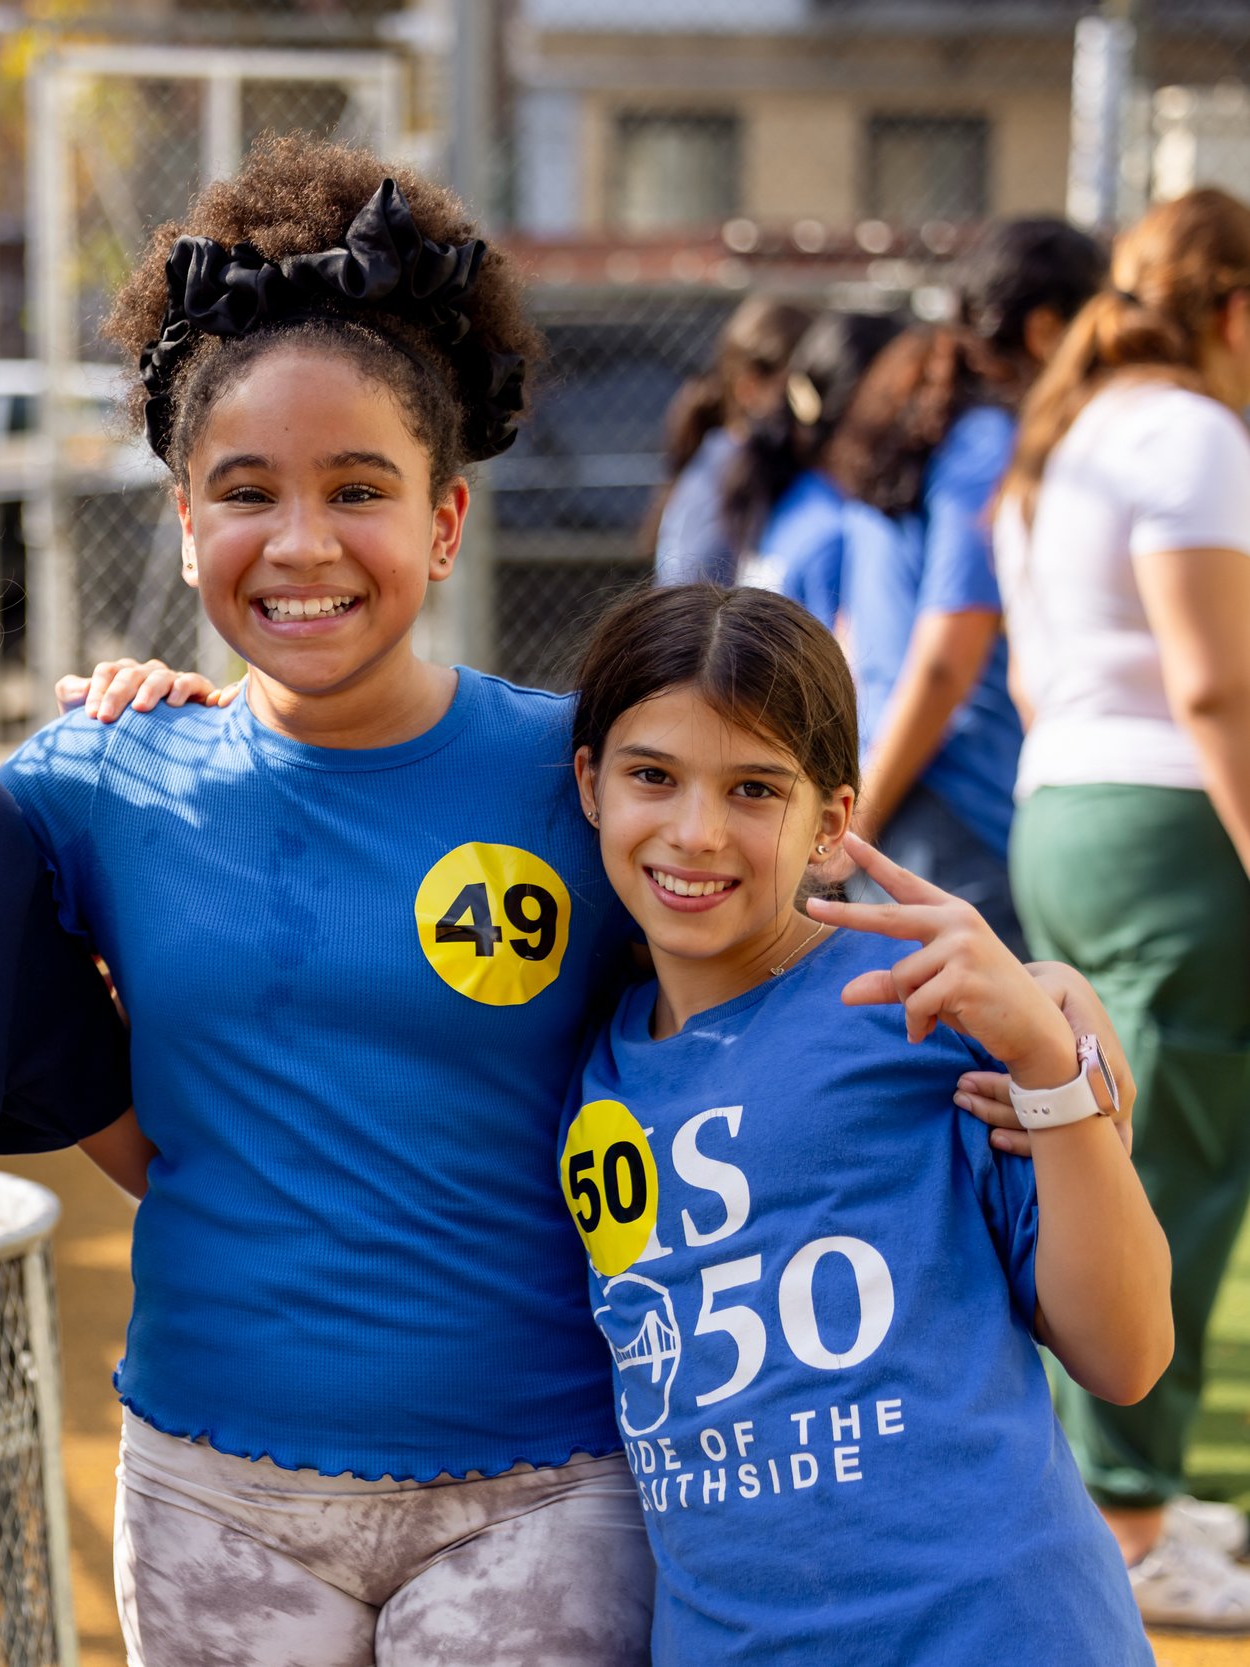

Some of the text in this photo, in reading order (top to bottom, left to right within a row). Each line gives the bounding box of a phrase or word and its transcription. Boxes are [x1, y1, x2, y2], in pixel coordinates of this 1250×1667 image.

[435, 882, 559, 962] 49
[568, 1140, 648, 1235] 50
[630, 1104, 751, 1262] S
[693, 1235, 896, 1407] 50
[625, 1398, 906, 1475] IDE OF THE
[639, 1446, 863, 1513] UTHSIDE
